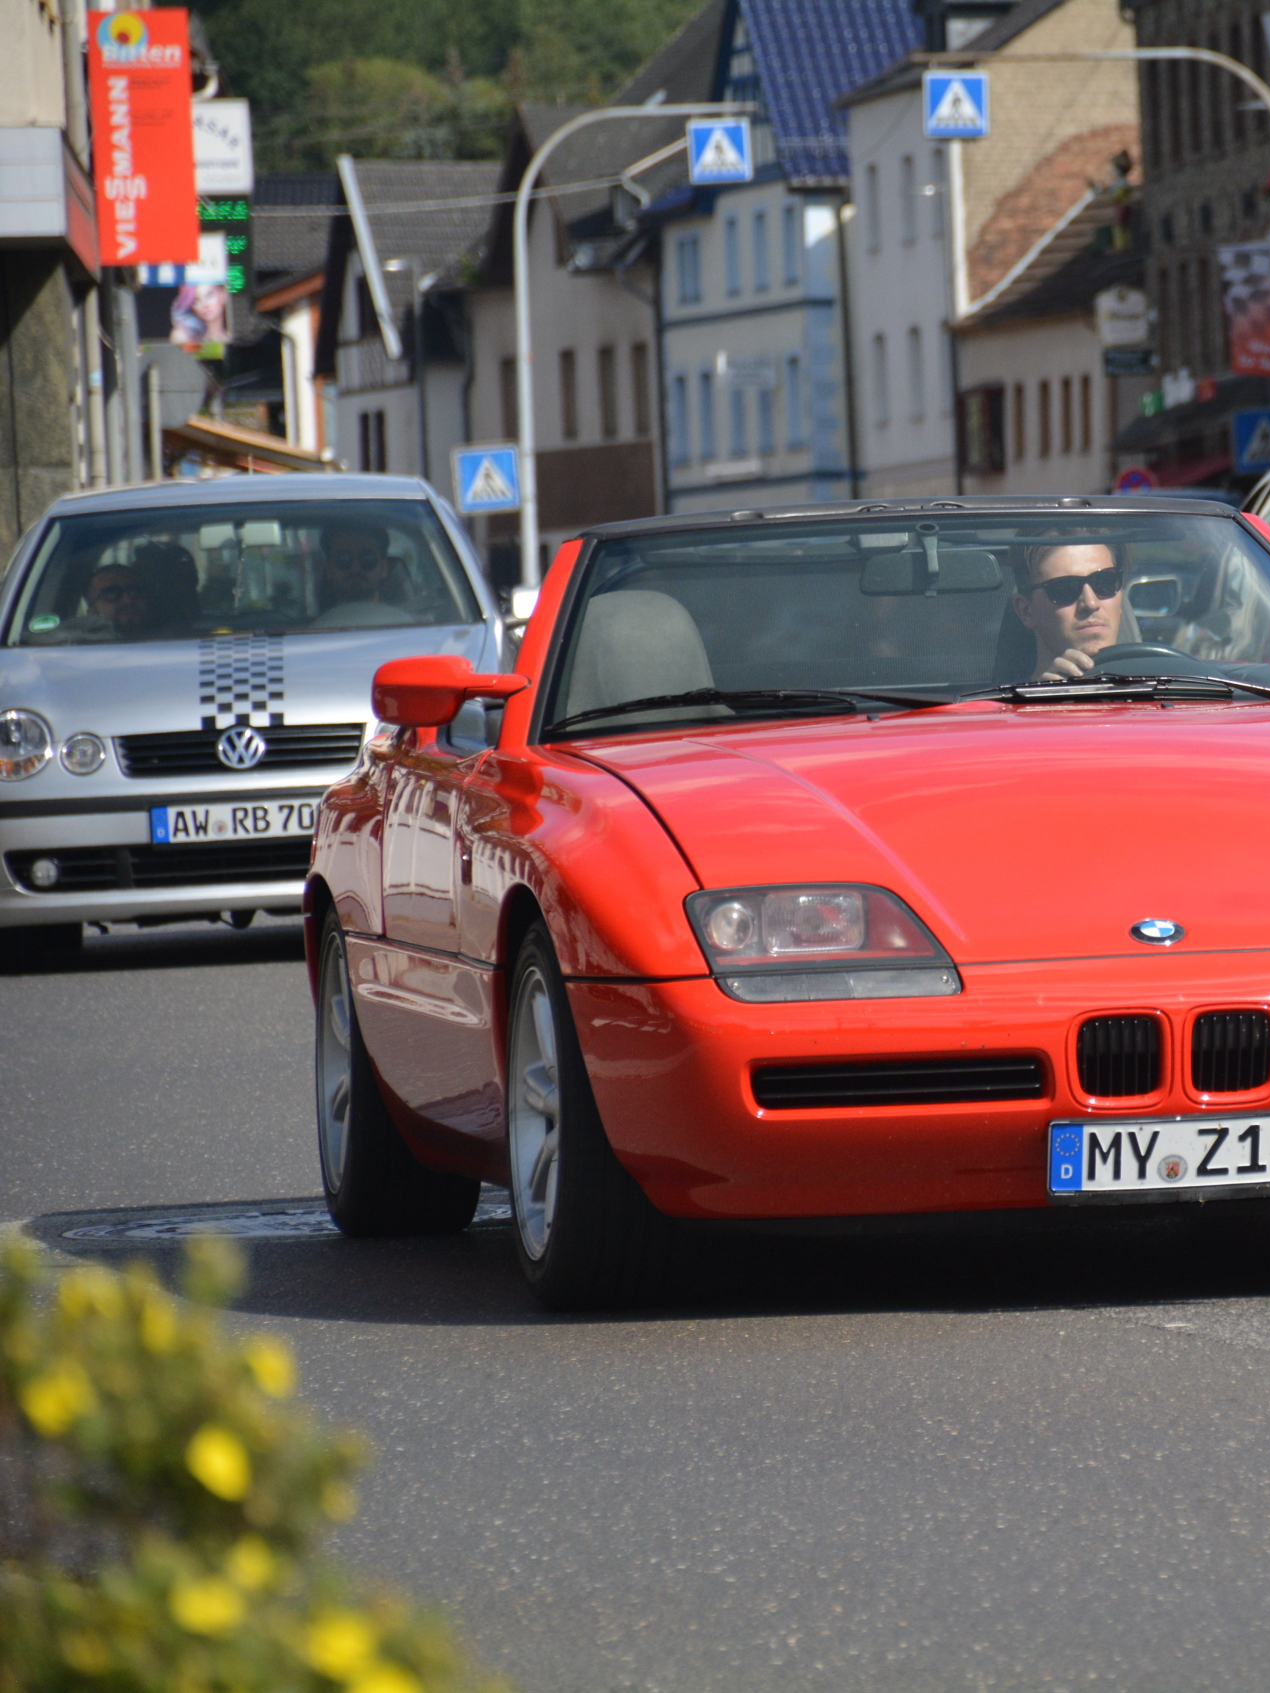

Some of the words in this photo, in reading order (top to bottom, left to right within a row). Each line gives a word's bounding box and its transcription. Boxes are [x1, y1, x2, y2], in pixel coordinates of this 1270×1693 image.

[172, 809, 209, 838] AW
[231, 806, 271, 834] RB
[278, 803, 318, 832] 70
[1087, 1130, 1160, 1181] MY
[1196, 1124, 1267, 1177] Z1
[1060, 1164, 1073, 1179] D
